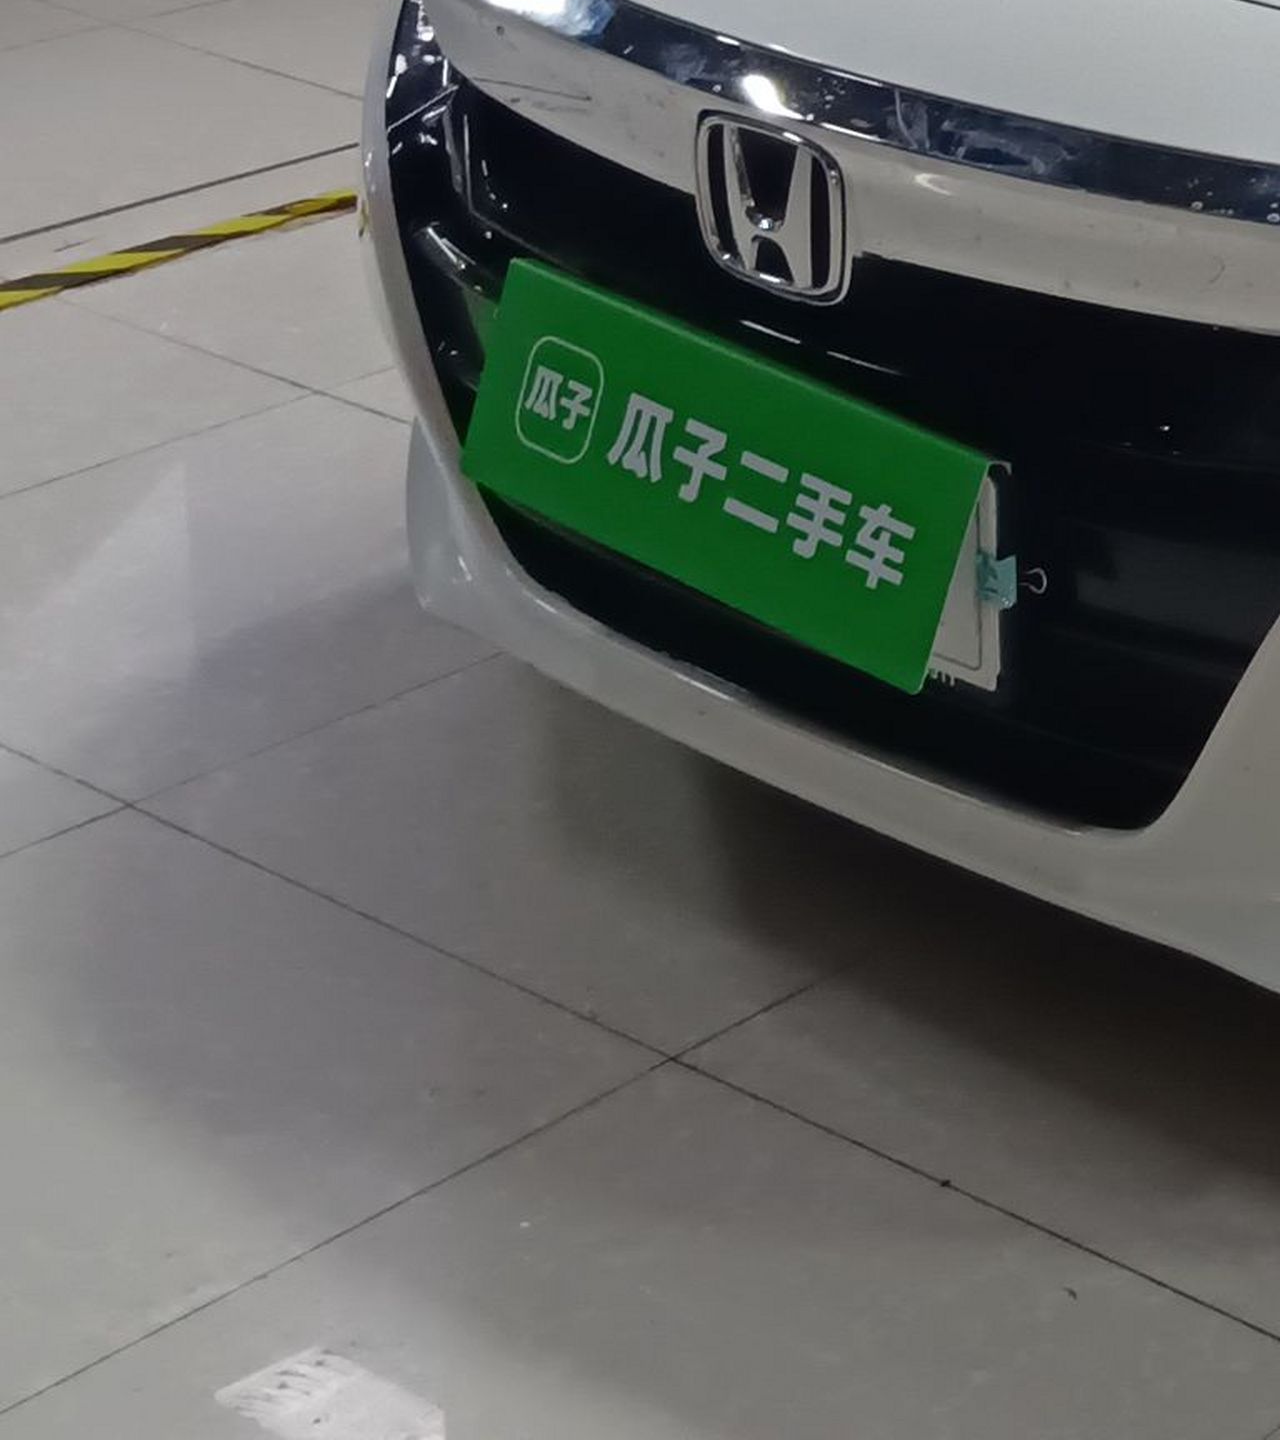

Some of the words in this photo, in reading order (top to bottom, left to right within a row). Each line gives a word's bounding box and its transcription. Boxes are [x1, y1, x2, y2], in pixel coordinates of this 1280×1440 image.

[523, 364, 593, 430] 瓜子
[606, 391, 916, 590] 瓜子二手车
